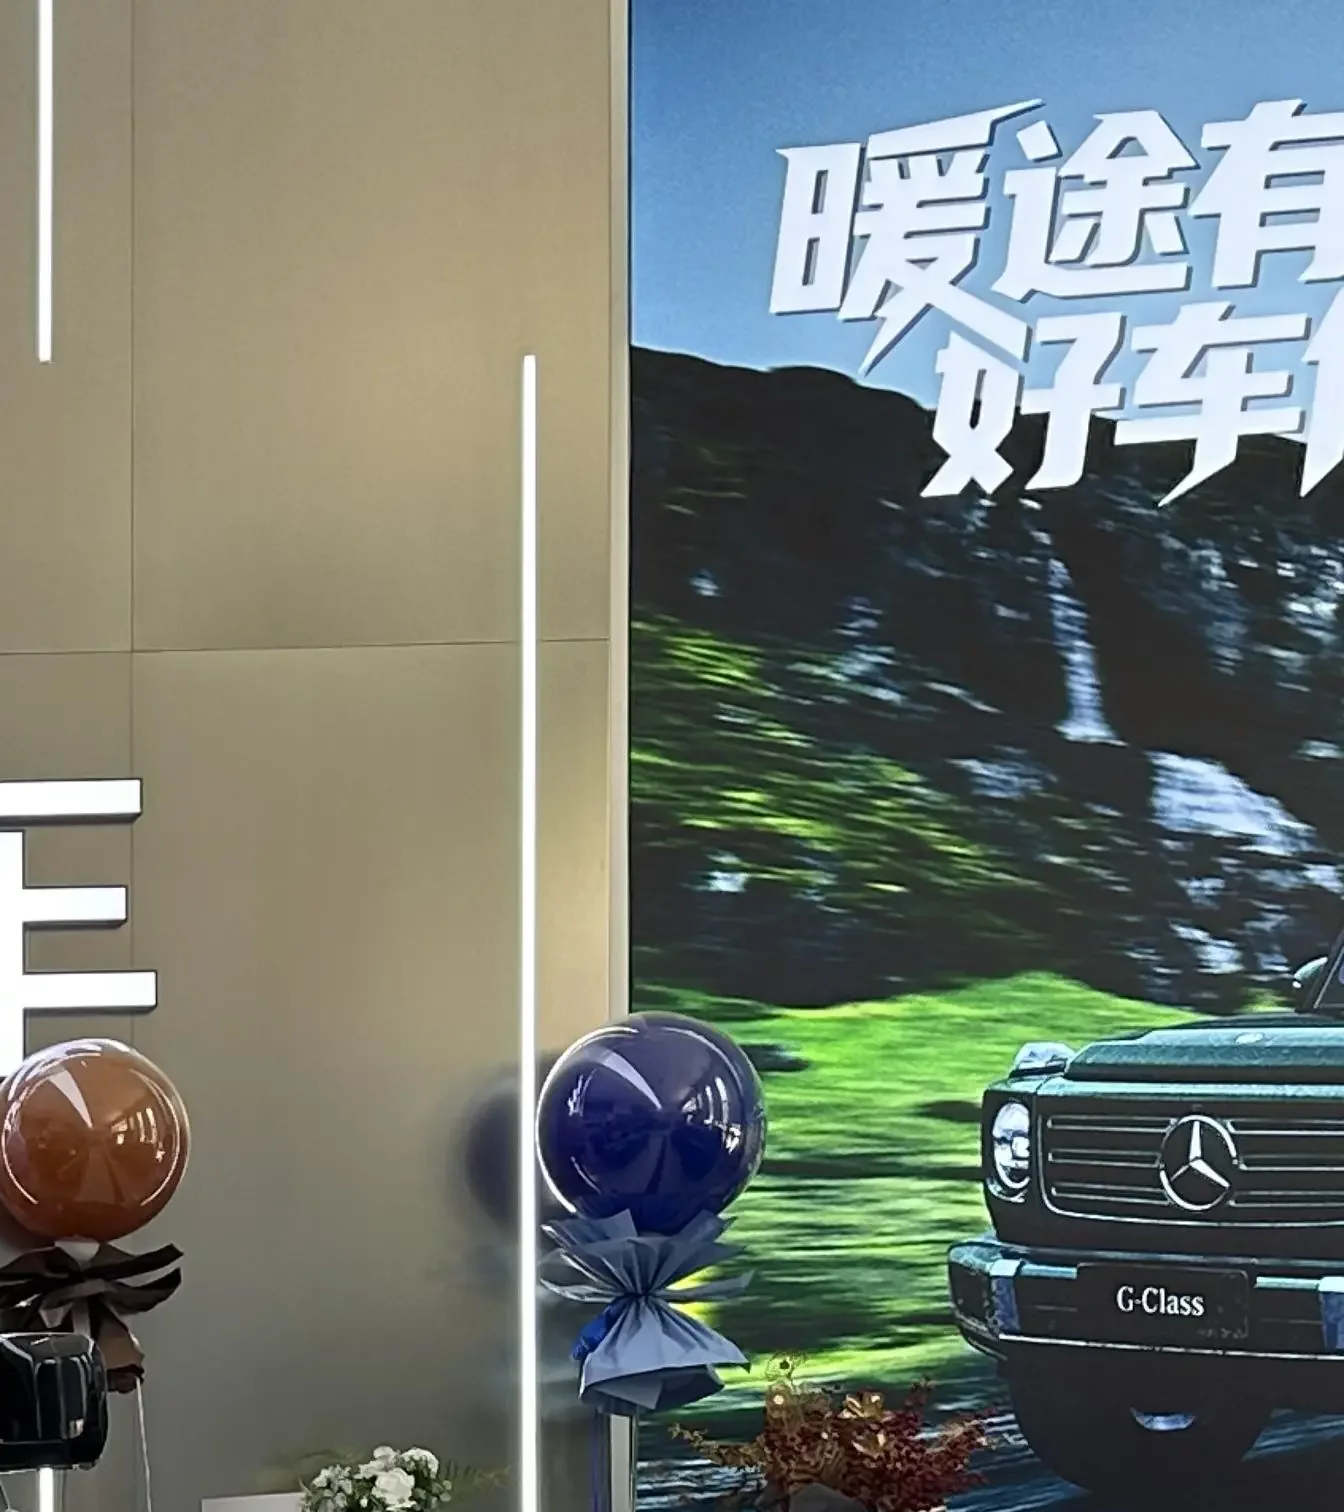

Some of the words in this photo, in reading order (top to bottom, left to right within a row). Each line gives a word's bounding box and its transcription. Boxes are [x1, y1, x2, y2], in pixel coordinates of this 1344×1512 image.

[769, 97, 1344, 378] 暖途有
[1116, 1285, 1205, 1316] G-Class
